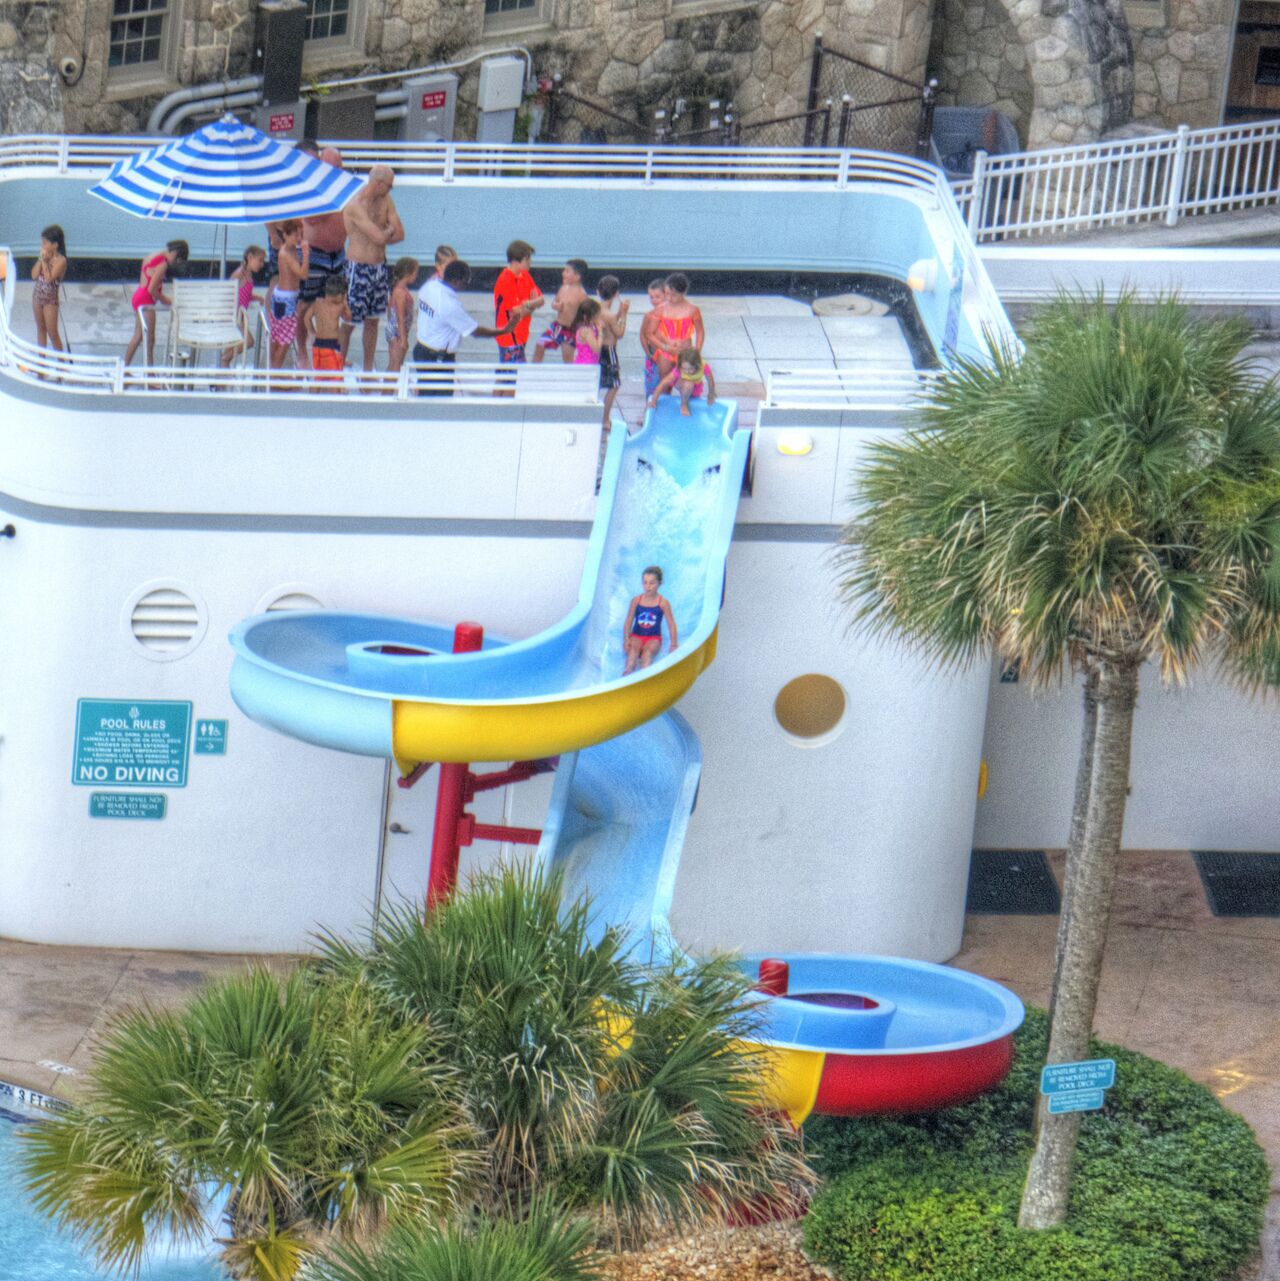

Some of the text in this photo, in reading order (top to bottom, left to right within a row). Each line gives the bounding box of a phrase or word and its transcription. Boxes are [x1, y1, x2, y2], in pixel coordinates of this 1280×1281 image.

[100, 718, 166, 730] POOL RULES
[80, 765, 180, 782] NO DIVING
[18, 1089, 43, 1106] 3 FT
